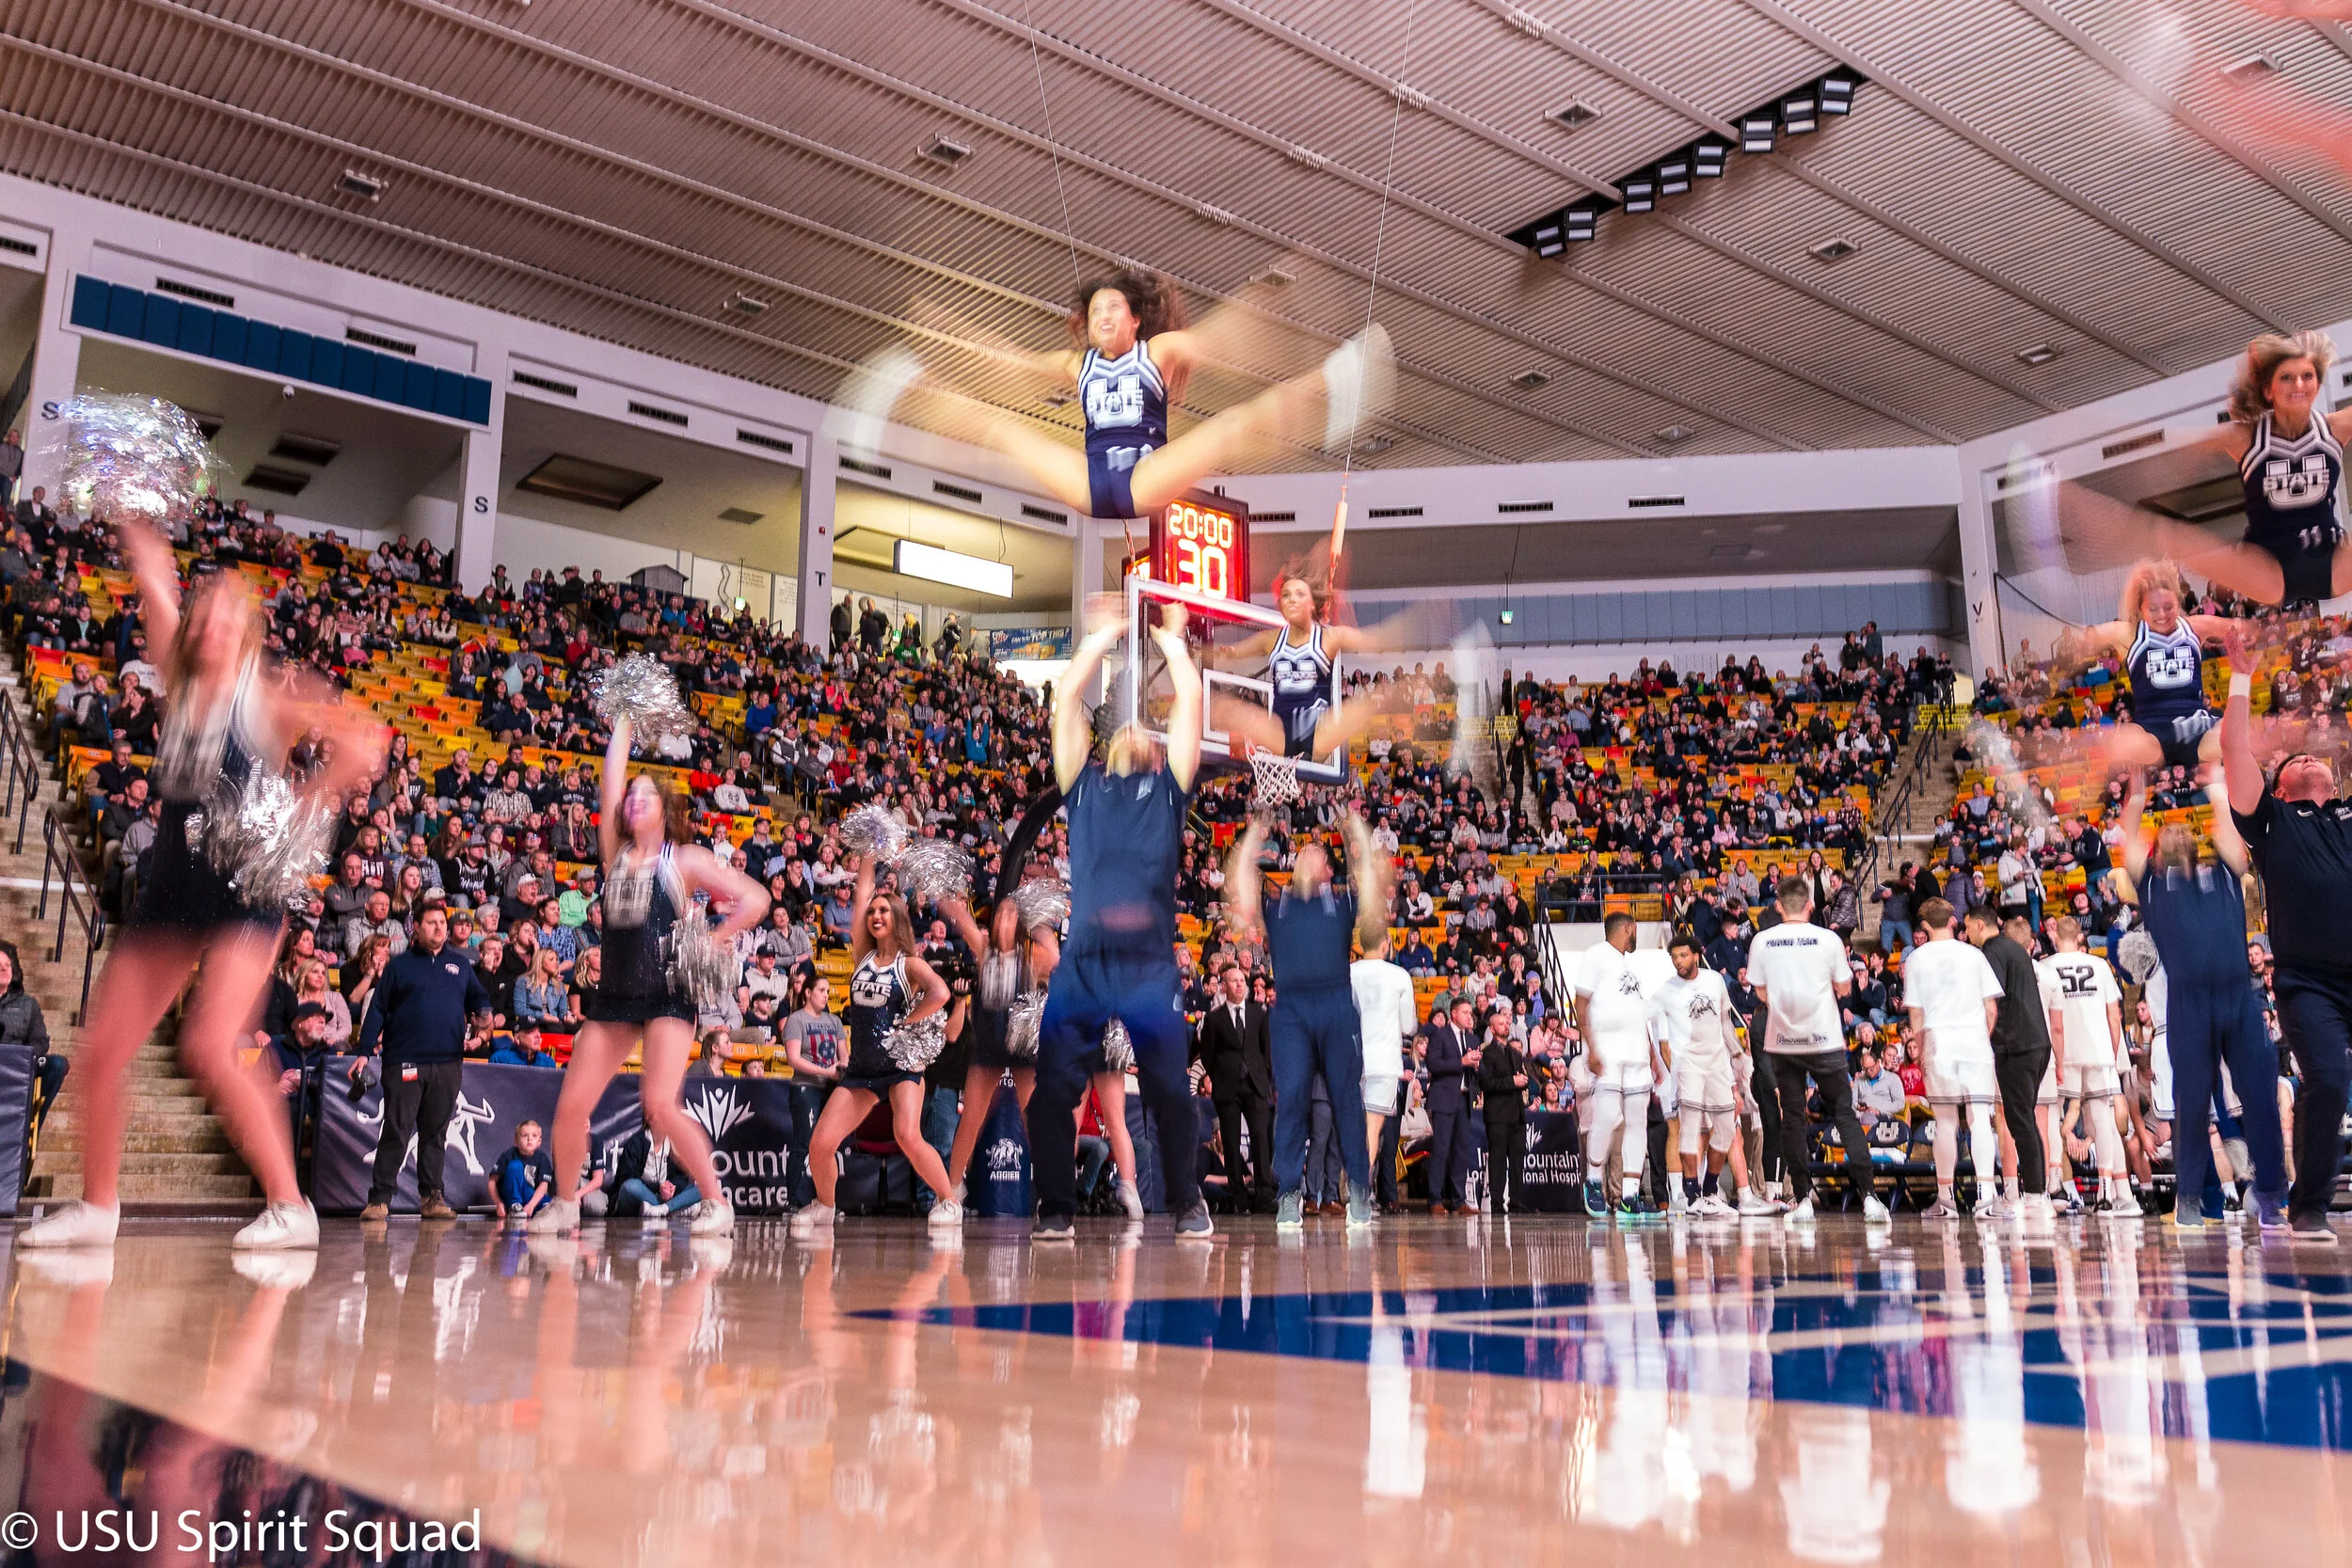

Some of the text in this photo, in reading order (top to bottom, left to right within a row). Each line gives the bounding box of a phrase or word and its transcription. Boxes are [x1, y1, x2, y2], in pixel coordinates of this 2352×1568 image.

[41, 401, 58, 420] S
[2263, 468, 2330, 496] STATE
[474, 496, 487, 513] S
[1169, 502, 1232, 549] 20:00
[815, 570, 826, 587] T
[1178, 538, 1227, 600] 30
[1972, 601, 1983, 616] V
[2146, 657, 2195, 676] STATE
[850, 979, 893, 998] STATE
[2056, 965, 2097, 993] 52
